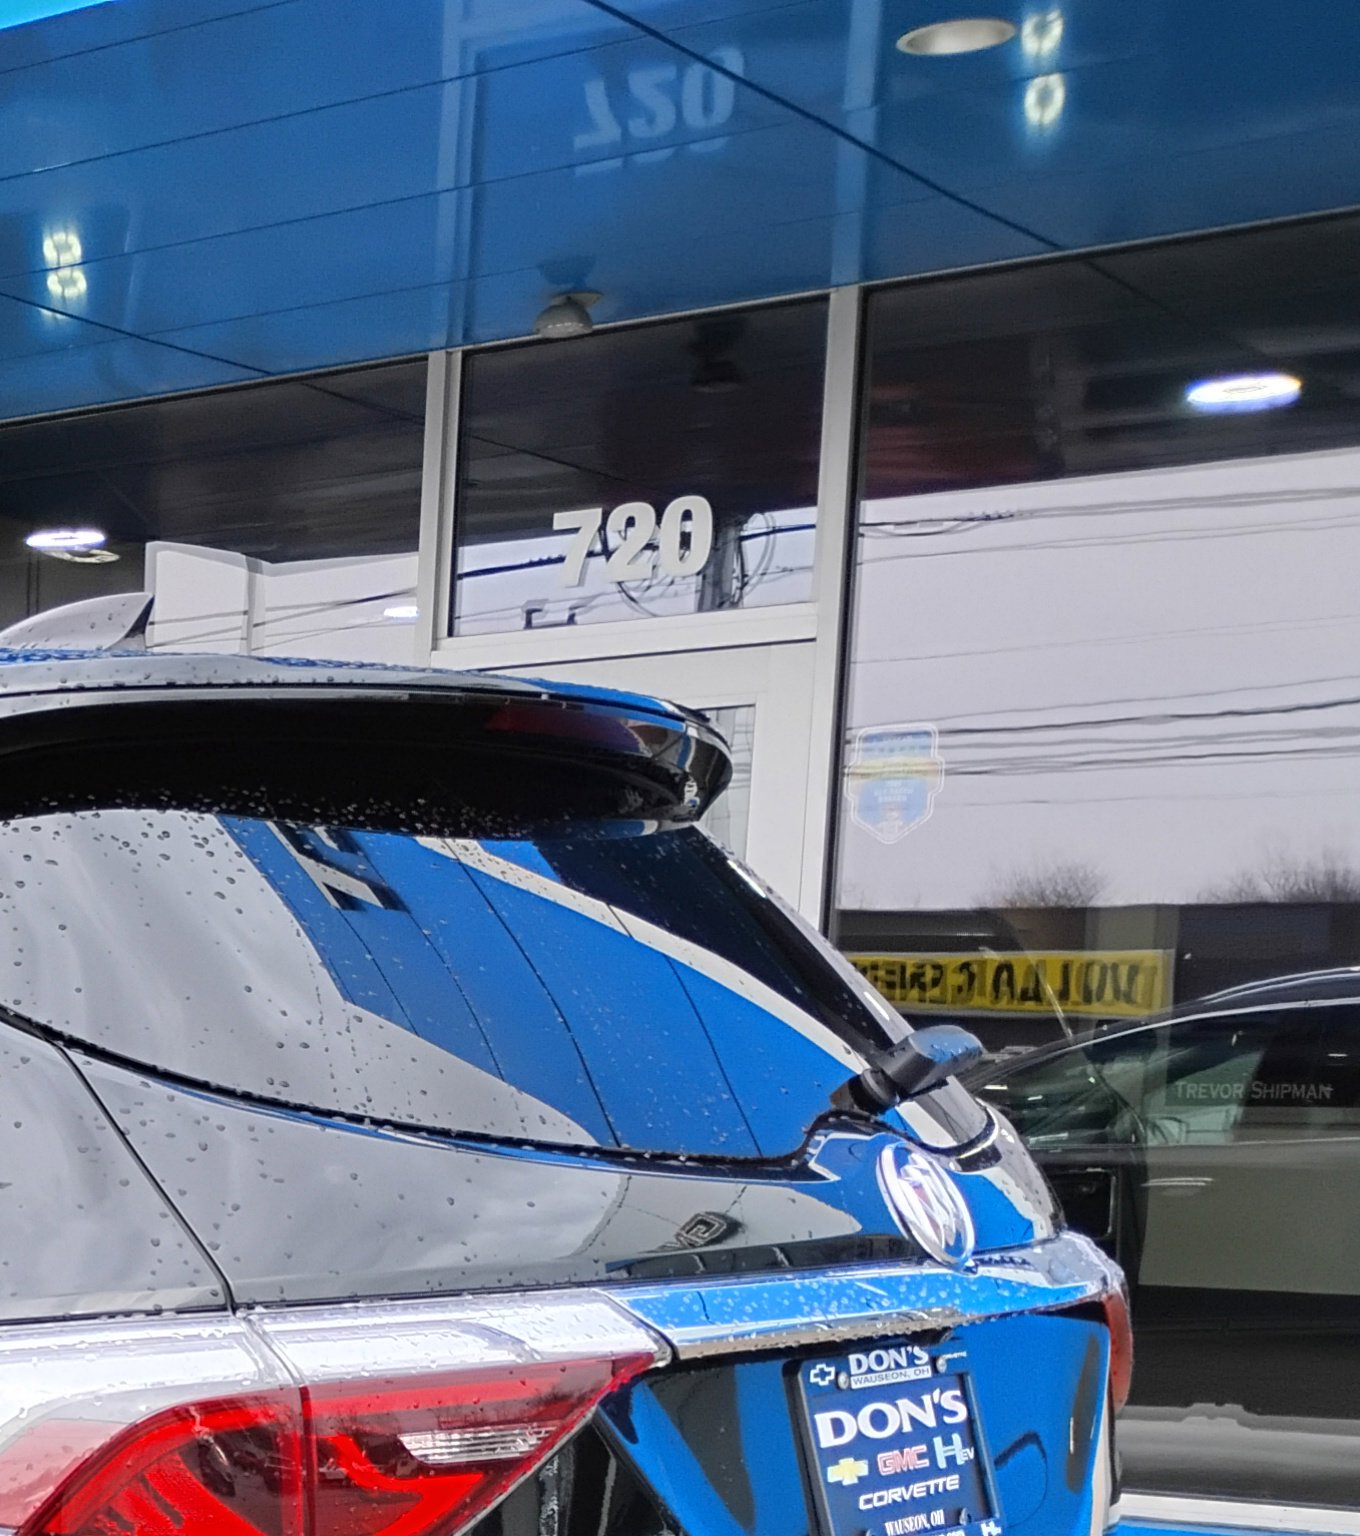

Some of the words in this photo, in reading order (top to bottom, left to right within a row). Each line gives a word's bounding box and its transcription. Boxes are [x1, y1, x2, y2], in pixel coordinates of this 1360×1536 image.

[551, 495, 715, 588] 720
[848, 1345, 930, 1375] DON'S
[853, 1370, 911, 1387] WAUSEON,
[913, 1366, 930, 1377] OH
[814, 1388, 968, 1449] DON'S
[877, 1444, 930, 1477] GMC
[858, 1474, 961, 1511] CORVETTE
